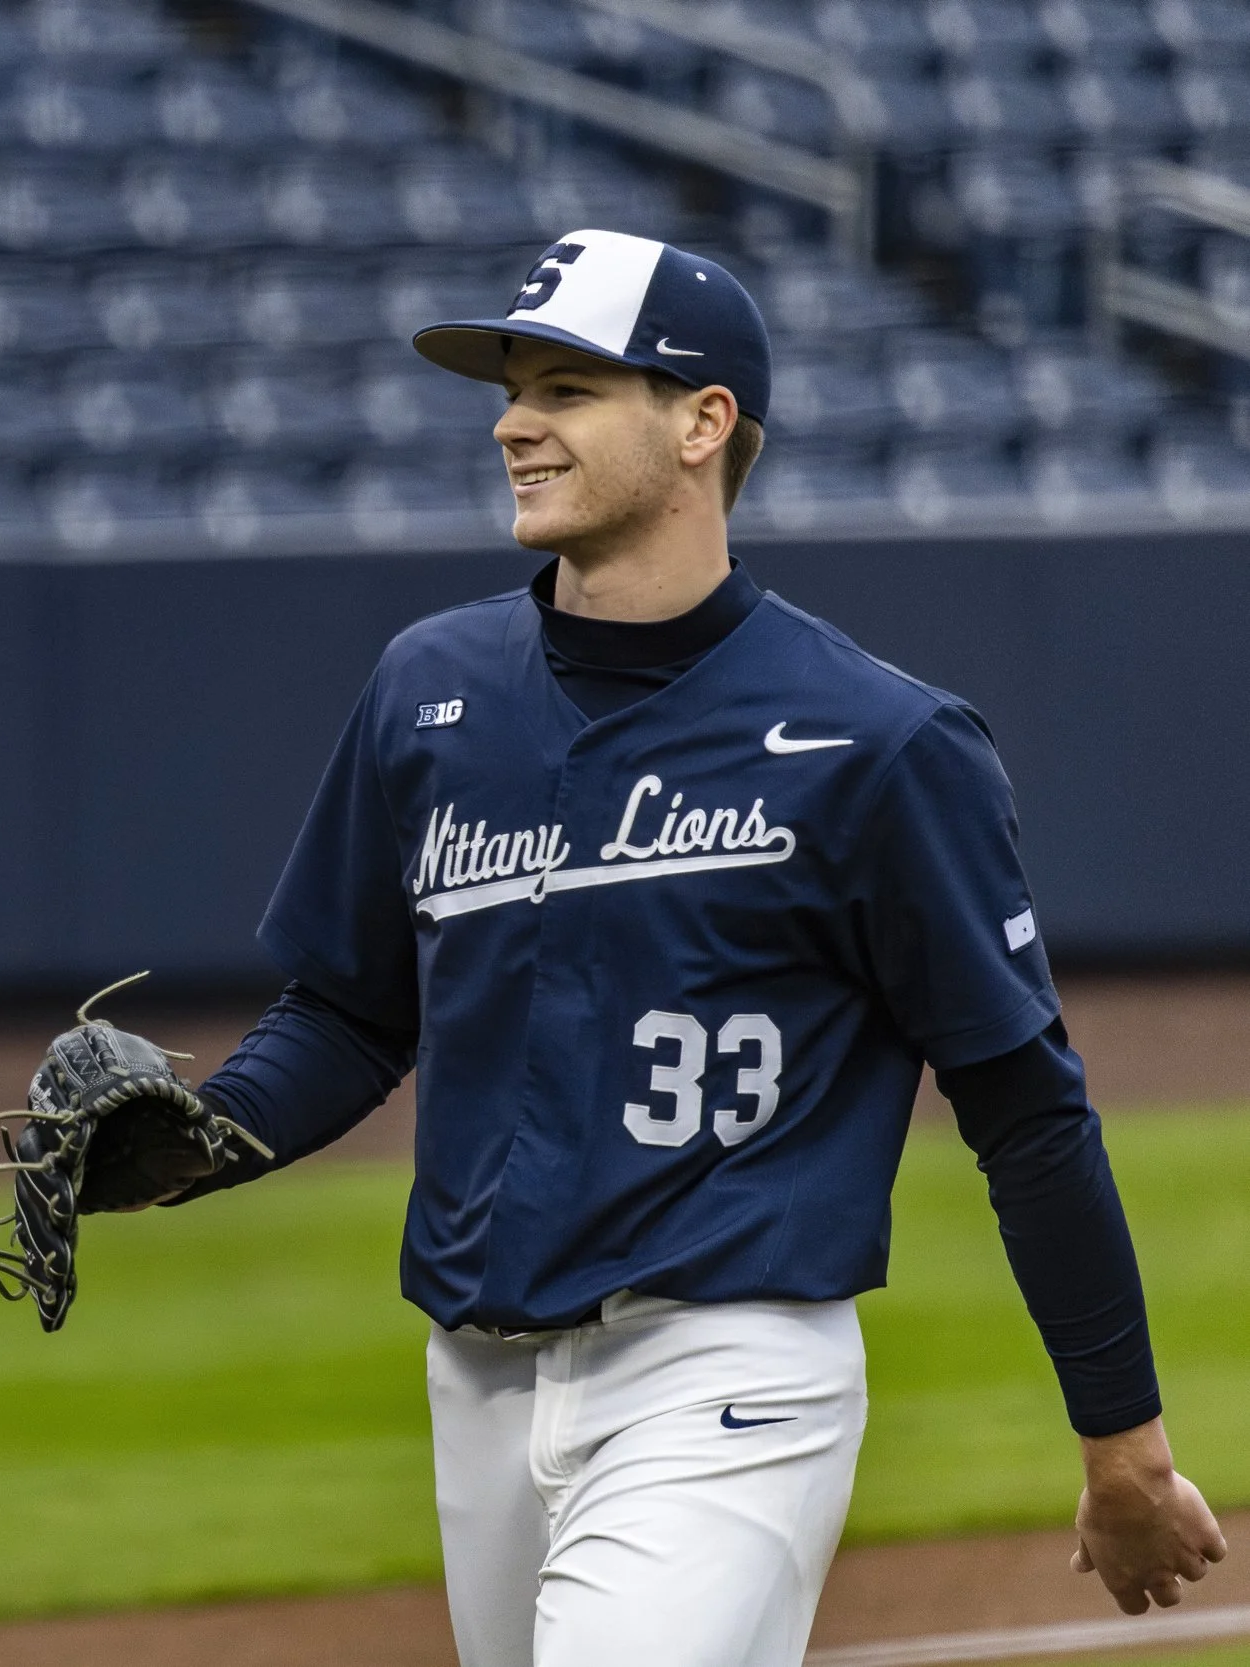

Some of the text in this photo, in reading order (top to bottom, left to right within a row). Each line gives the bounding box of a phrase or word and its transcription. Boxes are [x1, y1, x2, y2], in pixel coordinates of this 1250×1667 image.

[506, 242, 586, 317] S
[412, 774, 796, 904] Nittany Lions
[622, 1009, 782, 1148] 33
